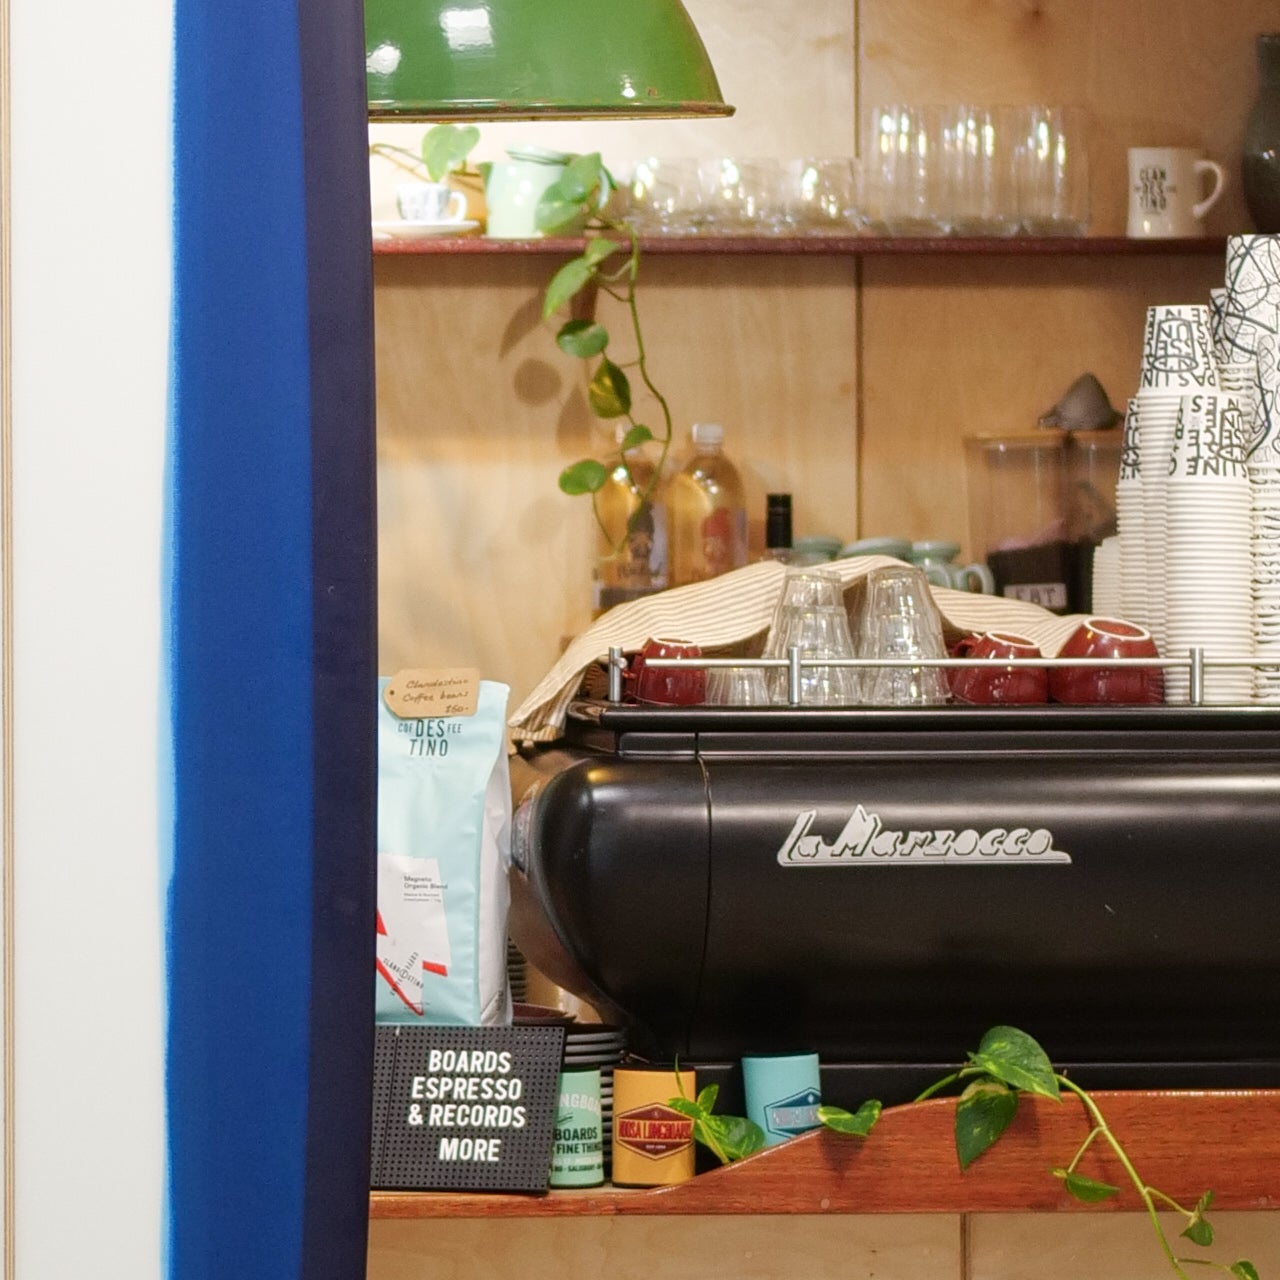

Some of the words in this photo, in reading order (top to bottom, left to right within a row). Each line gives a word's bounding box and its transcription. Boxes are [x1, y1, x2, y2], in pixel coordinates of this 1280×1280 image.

[402, 693, 435, 704] Coffee
[440, 690, 469, 700] beans
[398, 722, 413, 733] COF
[415, 719, 445, 738] DES
[446, 723, 463, 734] FEE
[409, 738, 449, 757] TINO
[830, 804, 1054, 860] Marzocco
[403, 883, 428, 891] Organic
[428, 1050, 512, 1074] BOARDS
[411, 1076, 522, 1101] ESPRESSO
[408, 1106, 424, 1127] &
[428, 1106, 527, 1128] RECORDS
[438, 1138, 501, 1162] MORE
[556, 1143, 580, 1154] FINE
